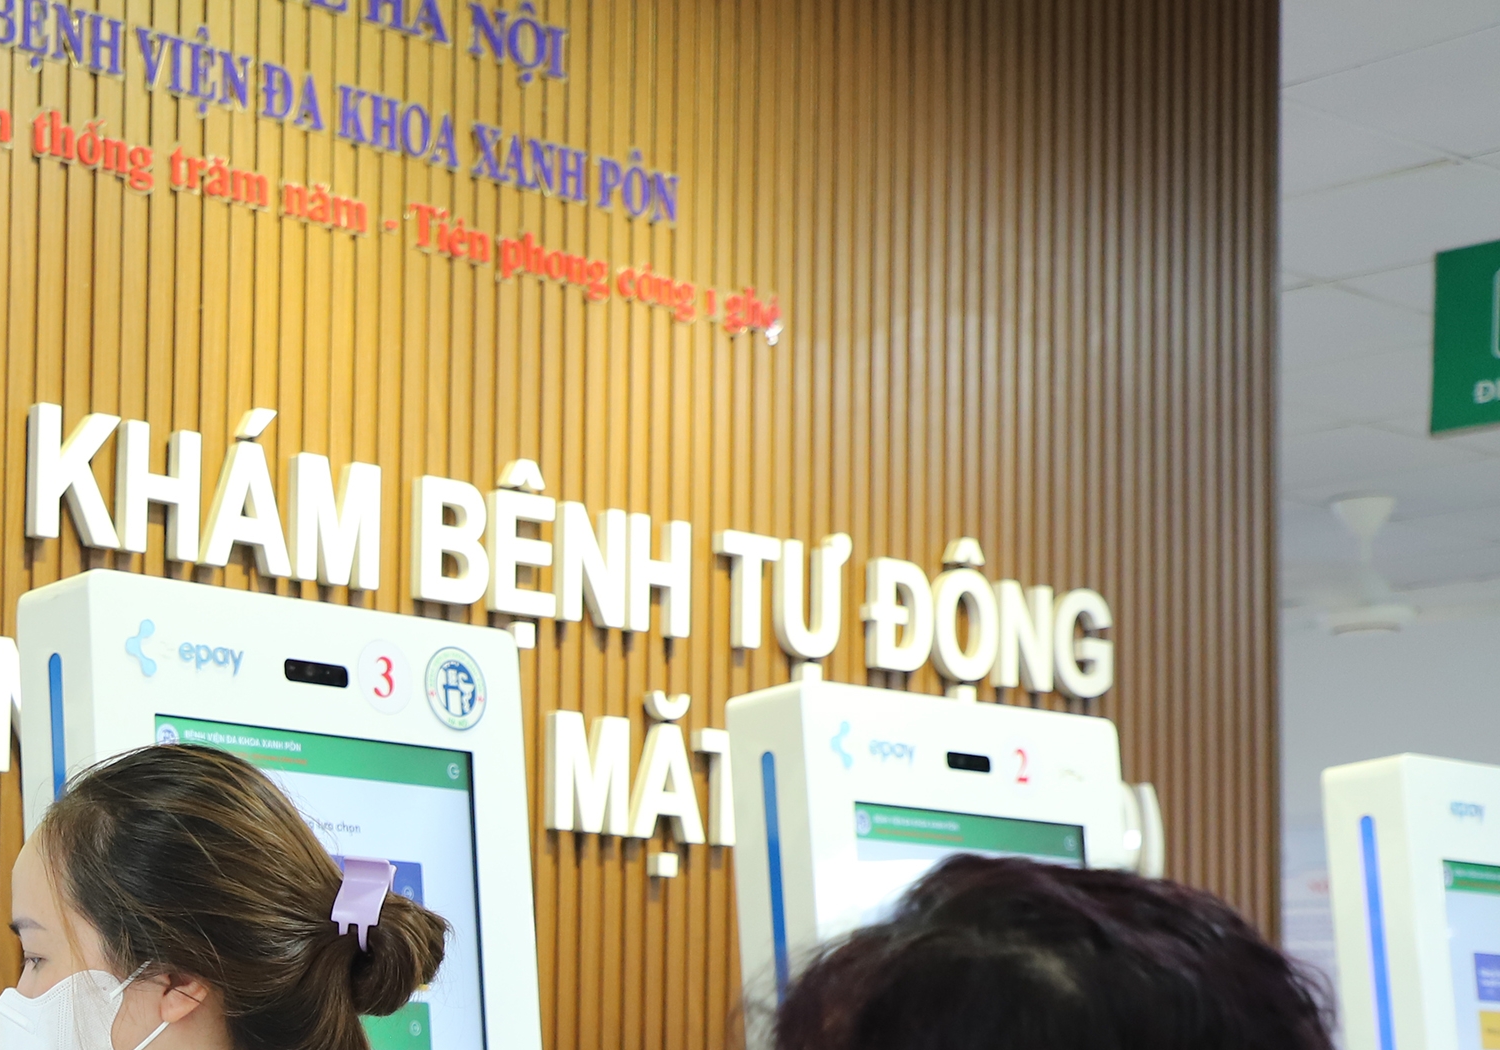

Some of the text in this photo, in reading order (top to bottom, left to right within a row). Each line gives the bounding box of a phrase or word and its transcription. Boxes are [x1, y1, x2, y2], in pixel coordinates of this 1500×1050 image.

[467, 2, 568, 83] NỘI
[134, 26, 251, 118] VIỆN
[261, 62, 324, 131] ĐA
[337, 84, 458, 171] KHOA
[471, 122, 587, 201] XANH
[596, 148, 680, 224] PÔN
[32, 108, 154, 193] thống
[170, 145, 270, 209] trăm
[282, 182, 368, 234] năm
[498, 231, 610, 301] phong
[617, 263, 696, 322] công
[26, 407, 382, 591] KHÁM
[411, 458, 692, 649] BỆNH
[712, 529, 852, 682] TỰ
[860, 536, 1116, 702] ĐỘNG
[178, 641, 245, 677] epay
[373, 655, 395, 698] 3
[869, 739, 915, 765] epay
[1015, 749, 1029, 783] 2
